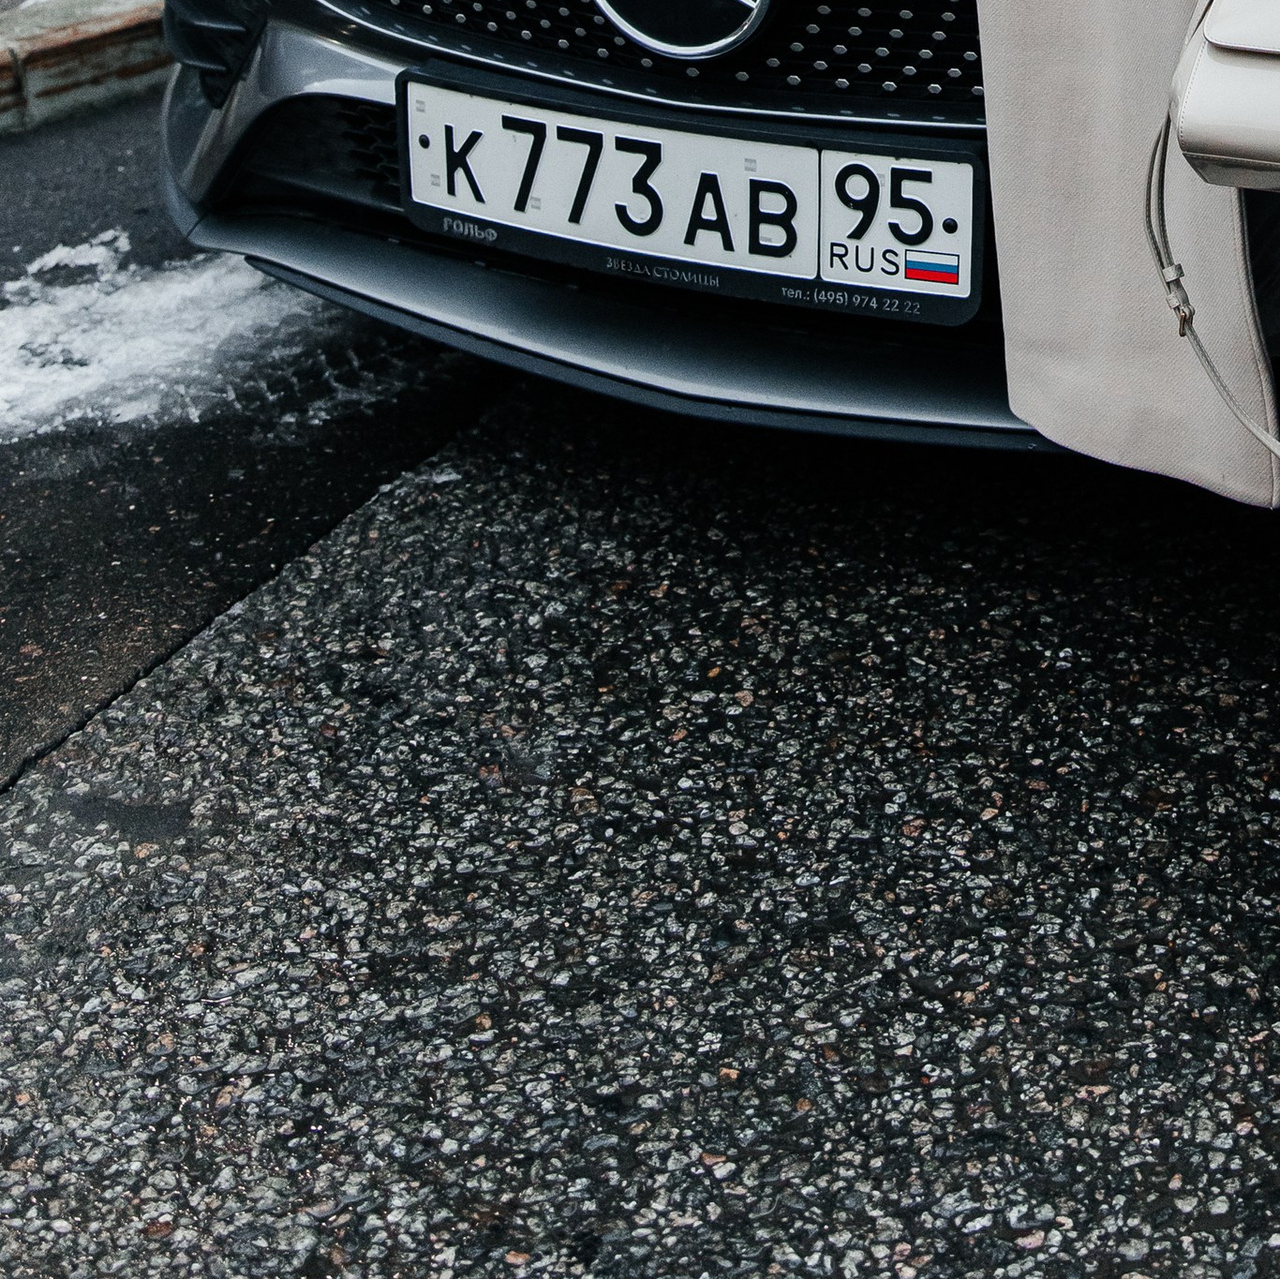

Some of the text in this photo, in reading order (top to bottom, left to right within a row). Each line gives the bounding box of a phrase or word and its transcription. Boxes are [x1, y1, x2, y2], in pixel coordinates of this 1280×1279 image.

[835, 163, 933, 246] 95
[829, 242, 900, 276] RUS
[653, 267, 719, 287] СТОЛИЦЫ
[814, 288, 848, 306] (495)
[852, 294, 878, 309] 974
[882, 298, 899, 312] 22
[904, 301, 920, 314] 22
